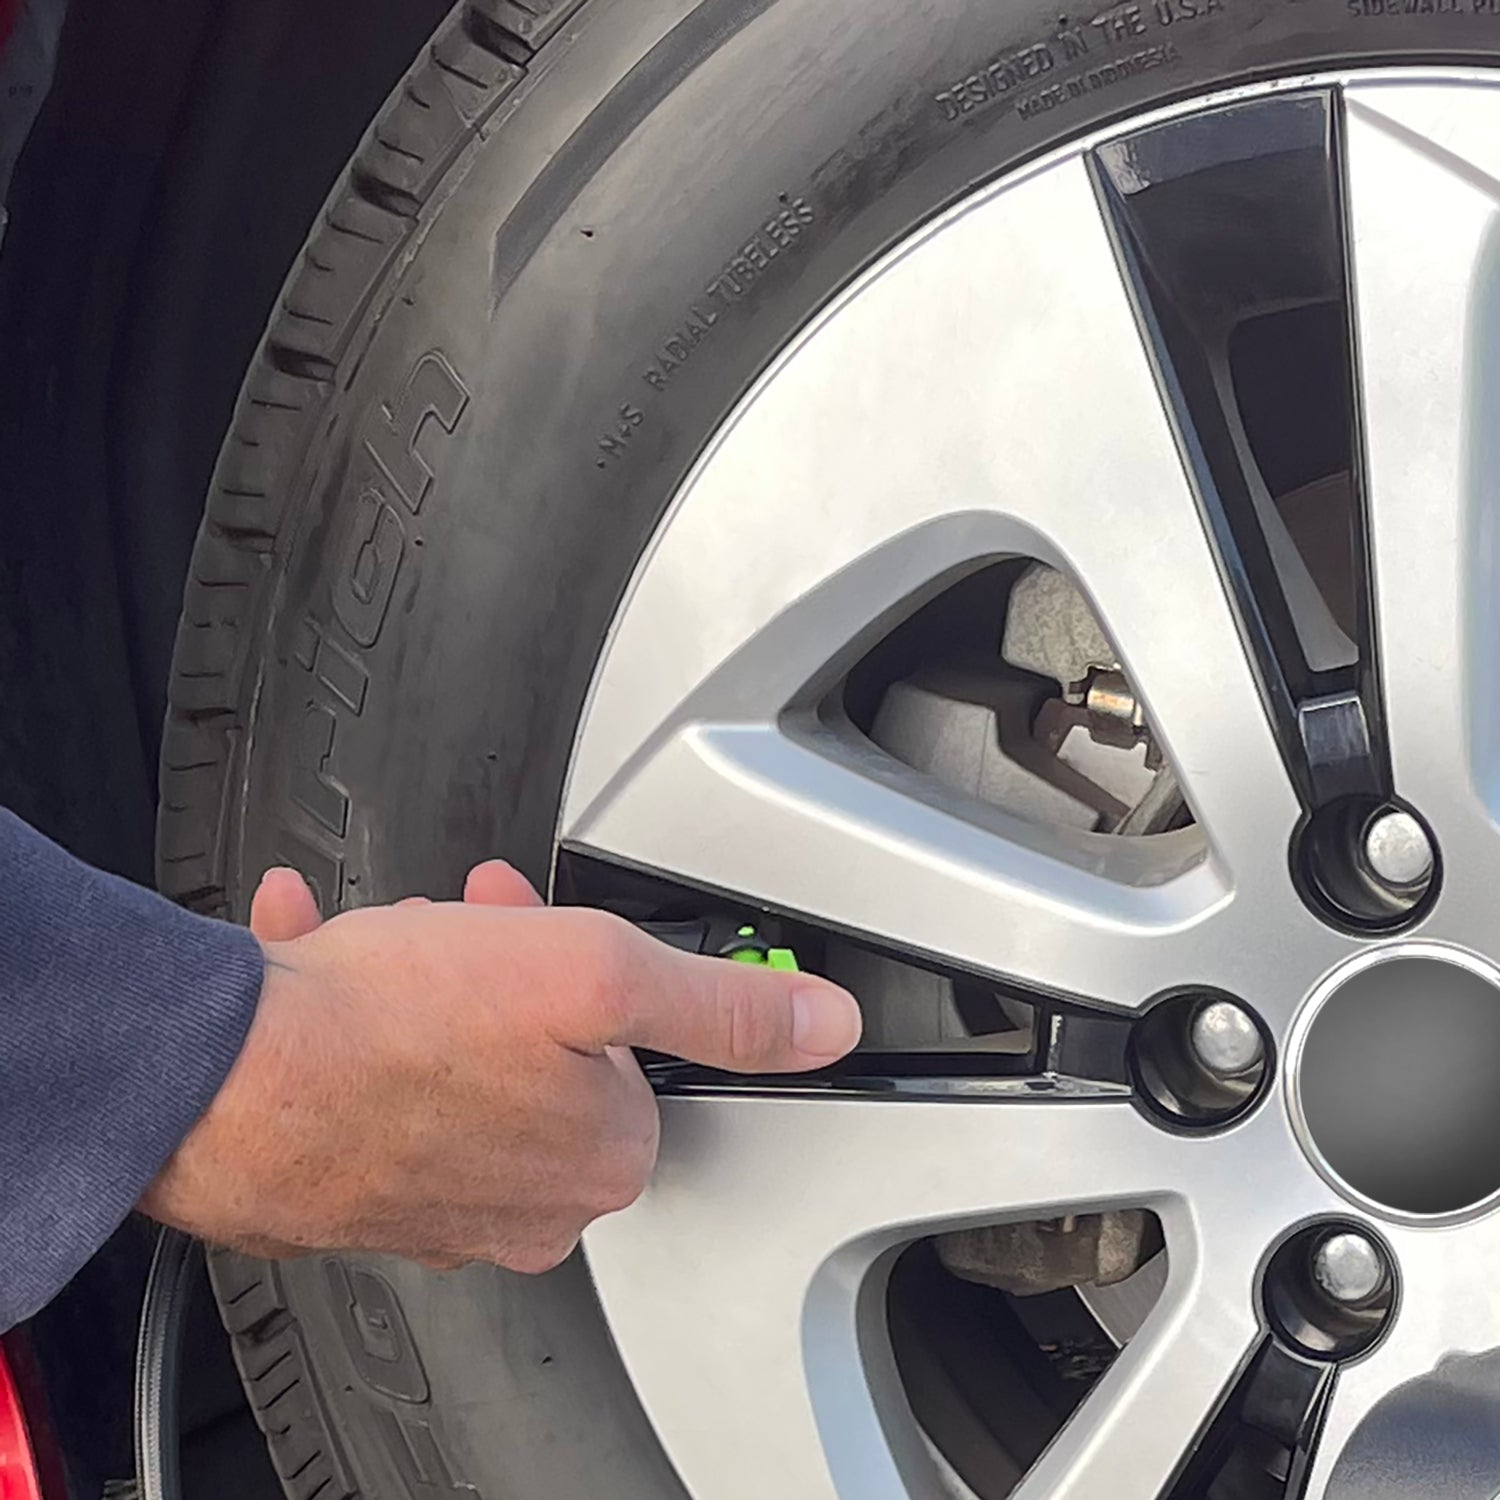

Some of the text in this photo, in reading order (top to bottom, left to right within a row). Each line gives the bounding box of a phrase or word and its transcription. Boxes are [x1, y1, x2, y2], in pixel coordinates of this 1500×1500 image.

[935, 43, 1055, 121] DESIGNED
[1058, 27, 1089, 61] IN
[1091, 5, 1146, 43] THE
[642, 304, 718, 392] RADIAL
[706, 198, 814, 300] TUBELESS
